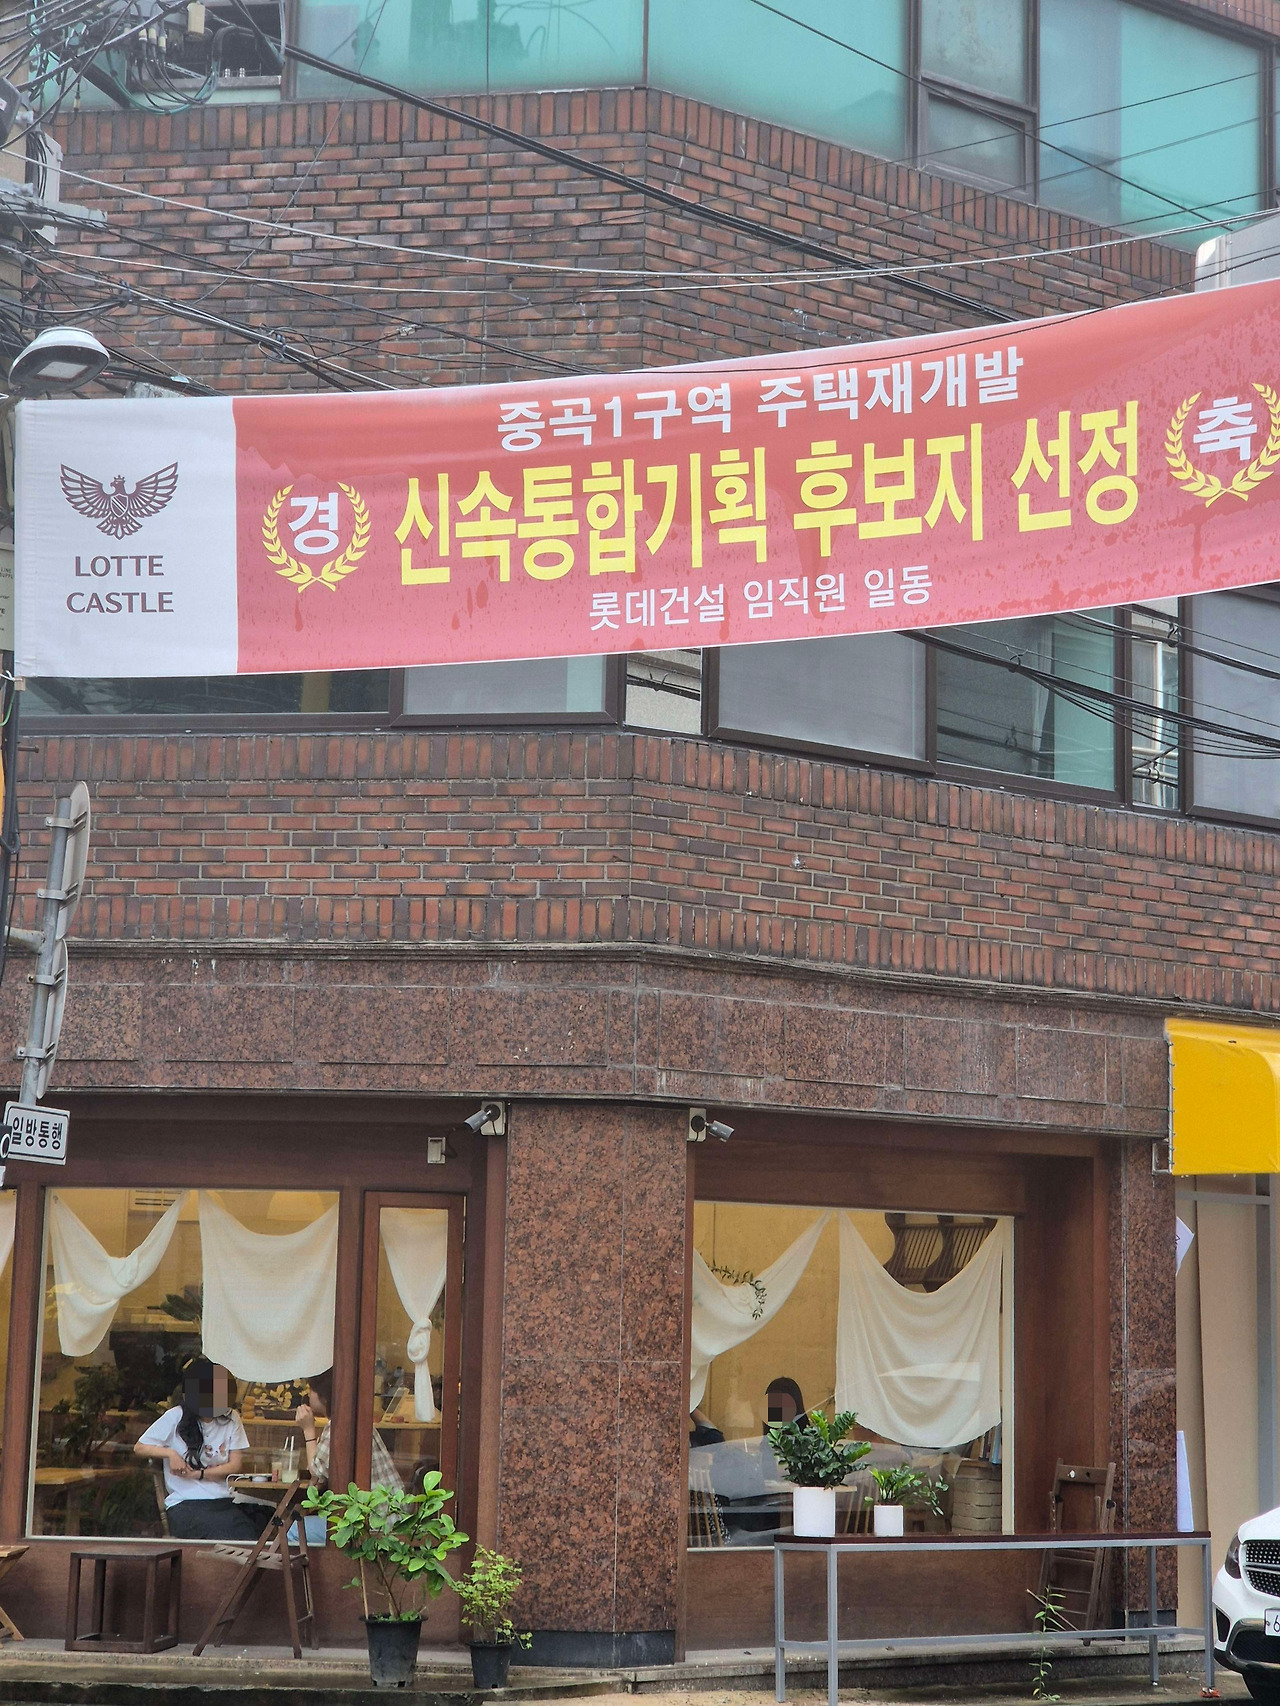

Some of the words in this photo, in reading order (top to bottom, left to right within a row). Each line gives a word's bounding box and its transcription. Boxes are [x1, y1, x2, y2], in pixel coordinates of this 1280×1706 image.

[498, 382, 732, 452] 중곡1구역
[757, 346, 1025, 429] 주택재개발
[1193, 396, 1258, 461] 축
[288, 492, 340, 555] 경
[395, 447, 768, 585] 신속통합기획
[794, 423, 984, 557] 후보지
[1011, 401, 1139, 532] 선정
[75, 555, 165, 577] LOTTE
[589, 584, 726, 631] 롯데건설
[744, 573, 847, 619] 임직원
[864, 565, 933, 608] 일동
[66, 591, 174, 614] CASTLE
[12, 1116, 63, 1150] 일방통행
